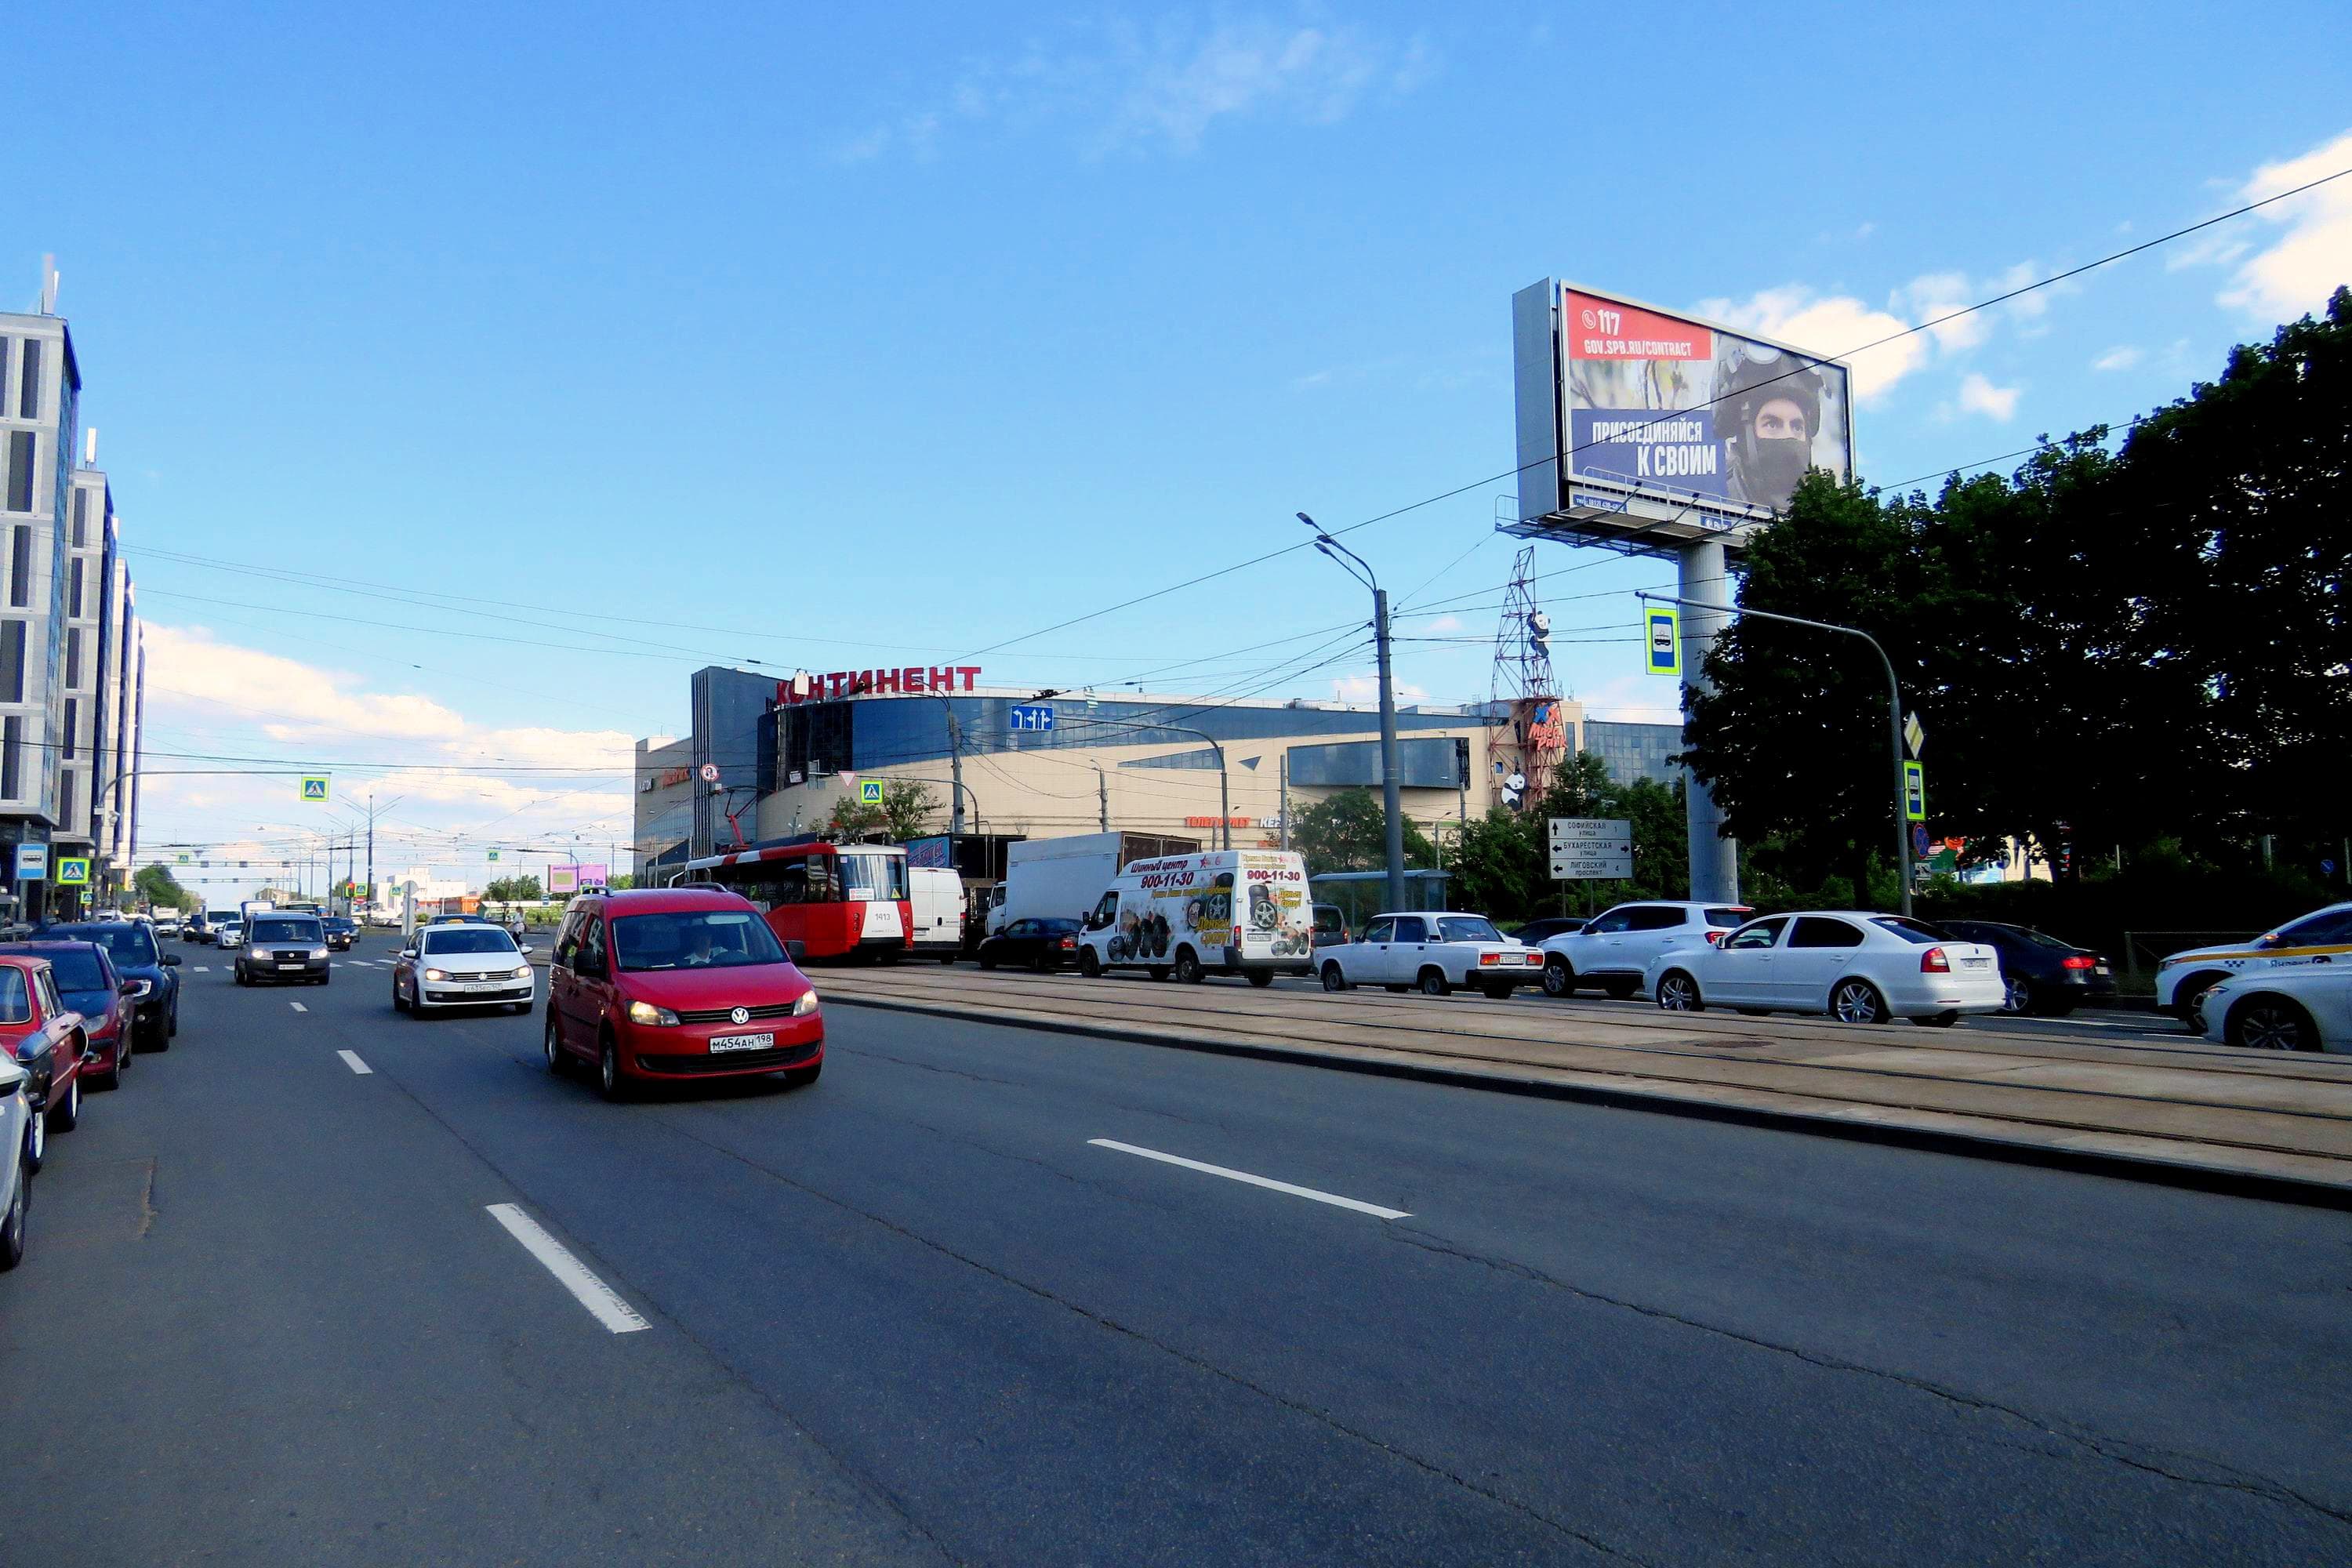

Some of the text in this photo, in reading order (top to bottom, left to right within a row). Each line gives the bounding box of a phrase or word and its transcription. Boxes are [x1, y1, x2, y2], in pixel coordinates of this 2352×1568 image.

[1598, 309, 1620, 336] 117
[1584, 339, 1692, 357] GOV.SPB.RU/CONTRACT
[1592, 417, 1702, 445] ПРИСОЕДИНЯЙСЯ
[1638, 445, 1716, 477] К СВОИМ
[1131, 860, 1189, 873] Шинный центр
[1570, 860, 1606, 869] ЛИГОВСКИЙ
[1141, 872, 1194, 888] 900-11-30
[1247, 870, 1300, 881] 900-11-30
[713, 1037, 754, 1049] М454АН
